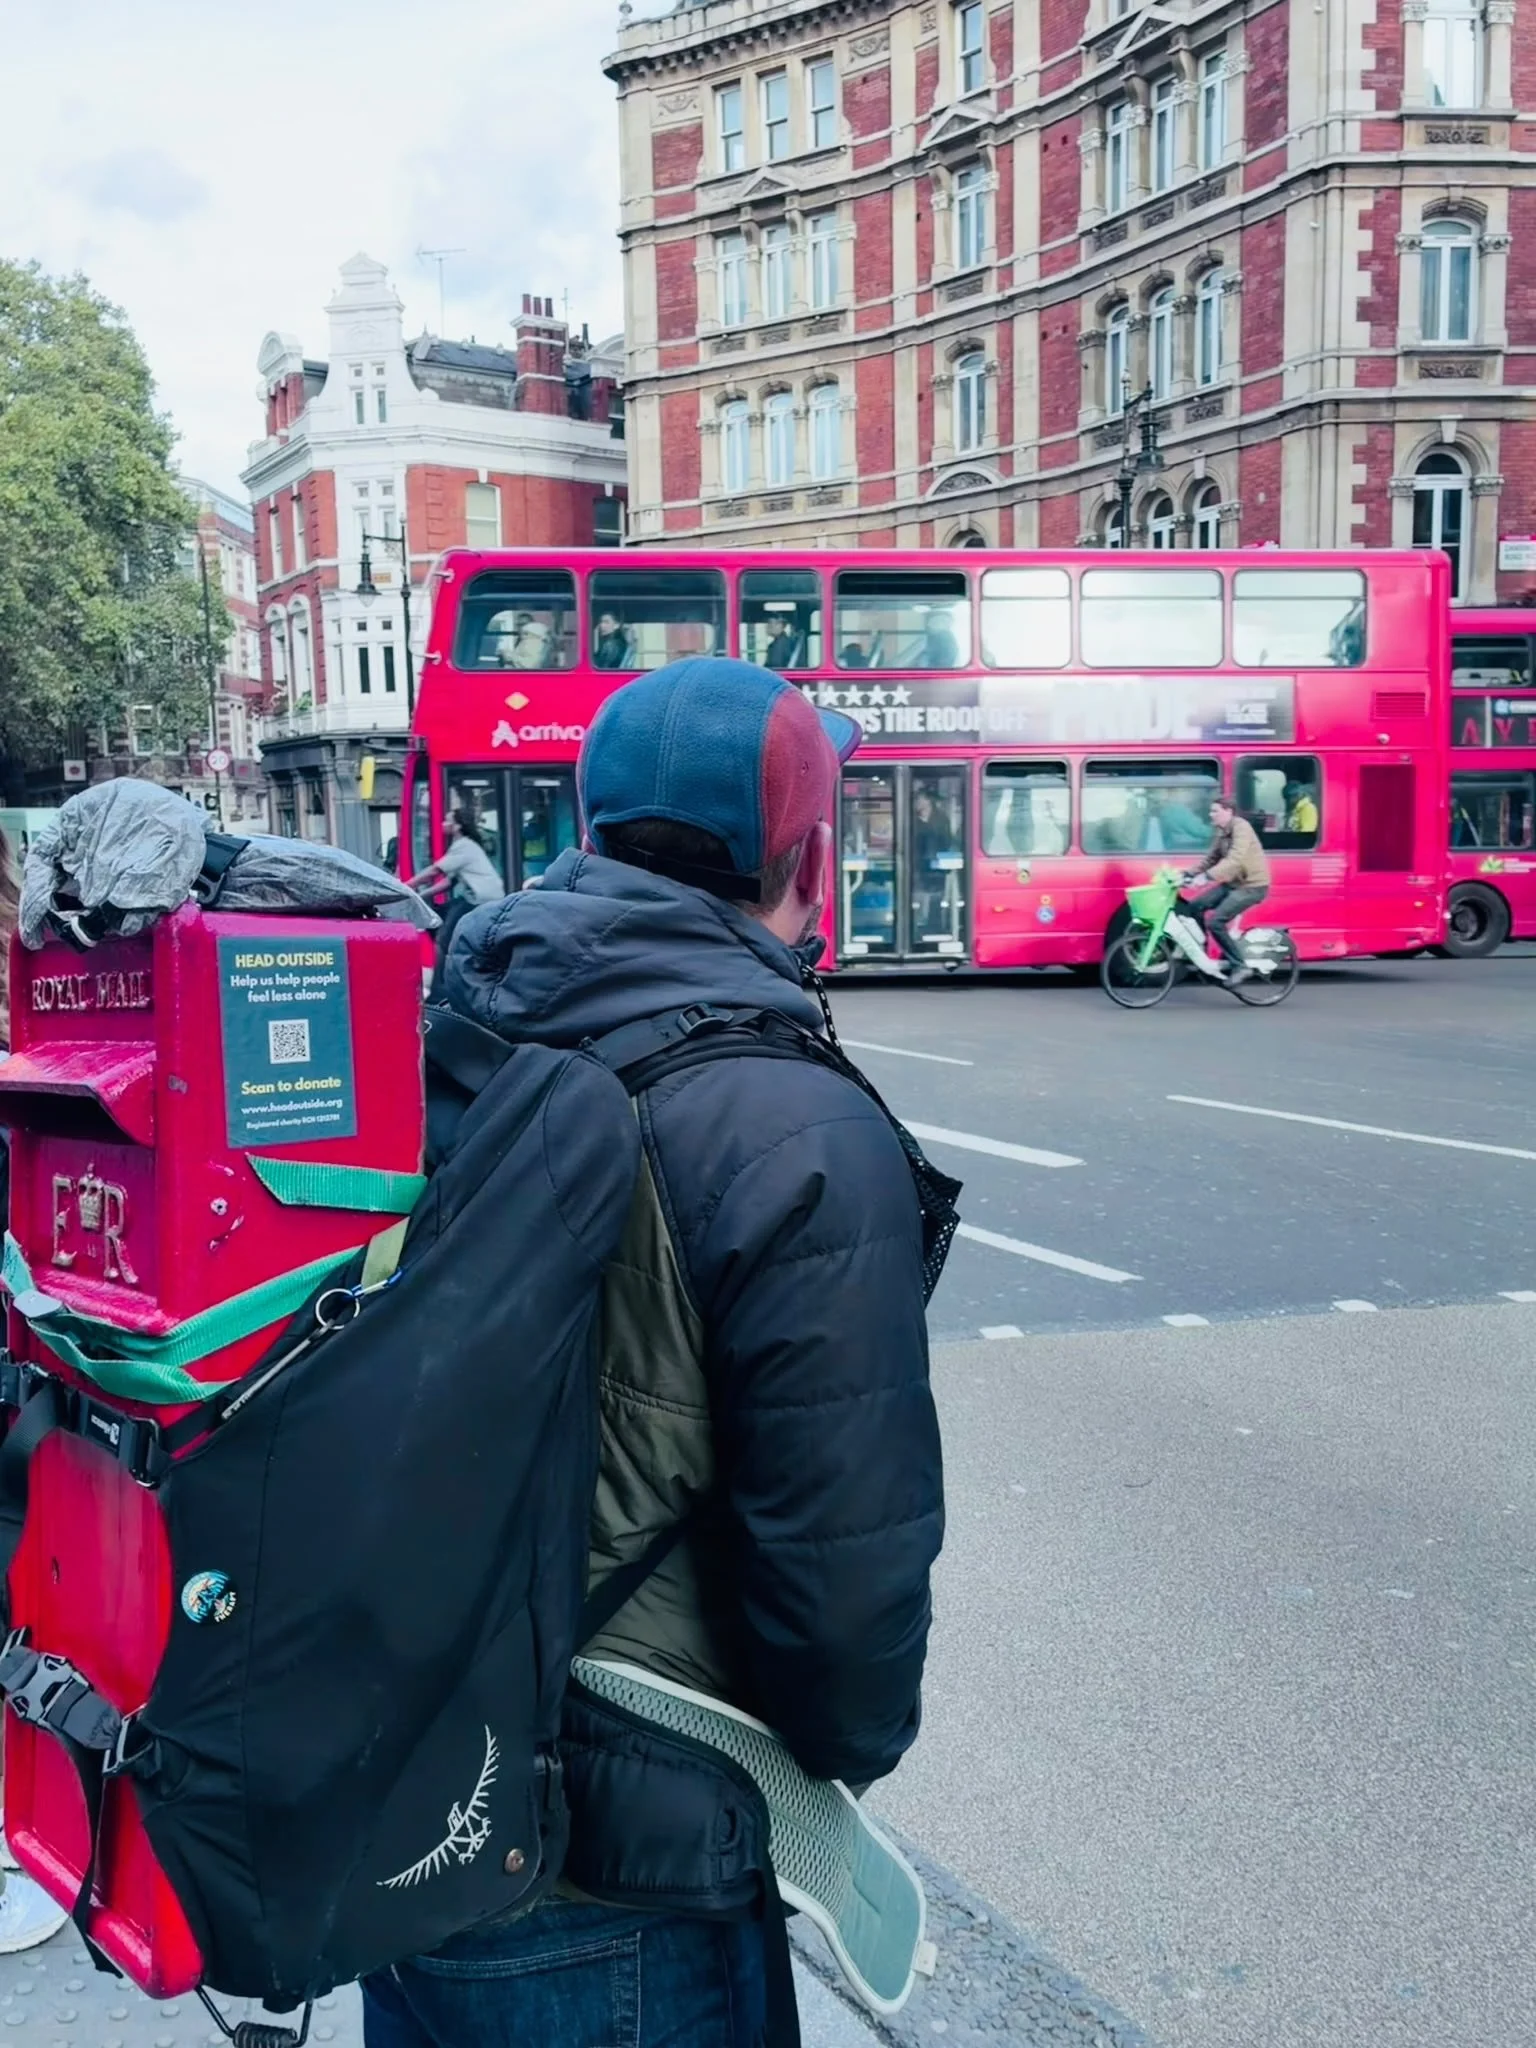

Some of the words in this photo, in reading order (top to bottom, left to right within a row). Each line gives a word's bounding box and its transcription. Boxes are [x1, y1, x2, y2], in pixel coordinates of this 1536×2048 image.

[882, 706, 925, 733] THE
[986, 705, 1028, 731] OFF
[519, 721, 585, 742] arriva
[211, 755, 227, 766] 20
[235, 953, 274, 969] HEAD
[276, 951, 334, 967] OUTSIDE
[230, 975, 259, 988] Help
[261, 975, 274, 985] us
[275, 973, 302, 987] help
[302, 971, 340, 986] people
[32, 973, 93, 1011] ROYAL
[95, 970, 151, 1009] MAIL
[247, 991, 270, 1003] feel
[271, 990, 293, 1002] less
[294, 988, 327, 1001] alone
[241, 1080, 274, 1095] Scan
[277, 1080, 293, 1093] to
[294, 1075, 342, 1091] donate
[241, 1097, 343, 1115] www.headoutside.org
[279, 1115, 302, 1127] charity
[213, 1591, 237, 1623] THERAPY
